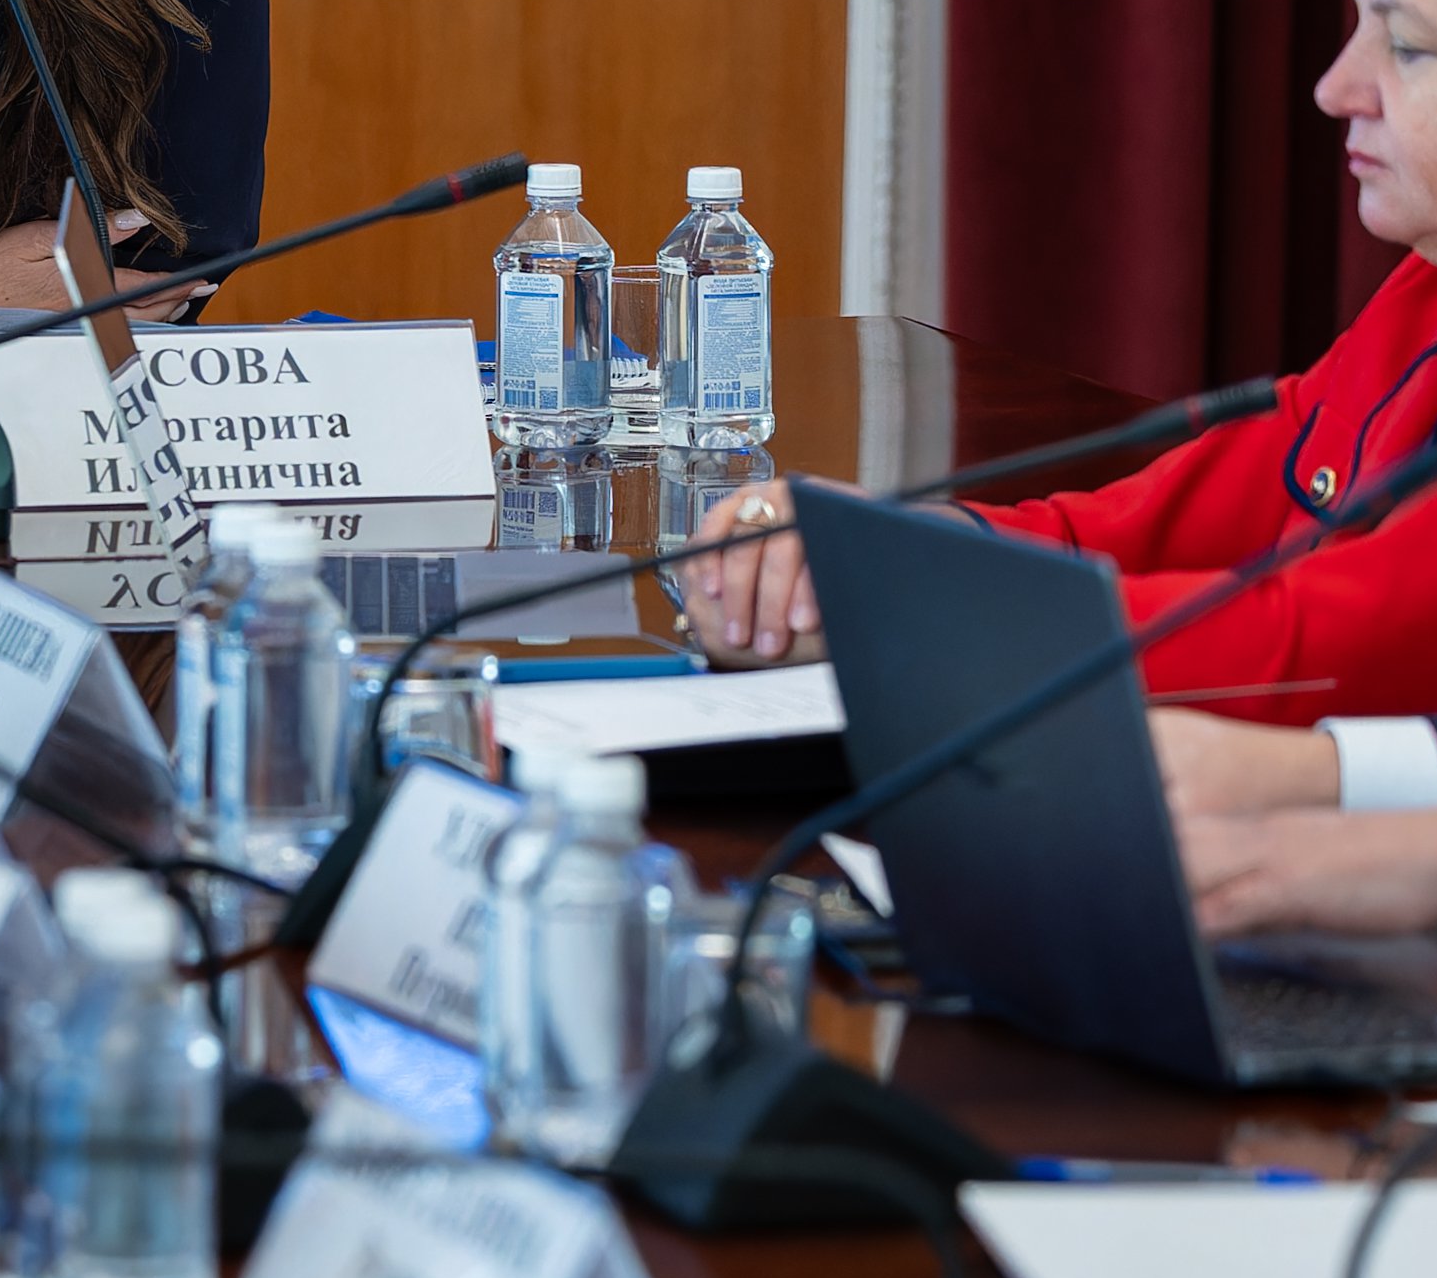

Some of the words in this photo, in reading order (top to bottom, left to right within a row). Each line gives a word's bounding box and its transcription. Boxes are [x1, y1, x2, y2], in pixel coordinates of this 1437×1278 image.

[135, 347, 311, 387] СОВА
[80, 409, 351, 451] Мргарита
[80, 457, 363, 494] Иинична
